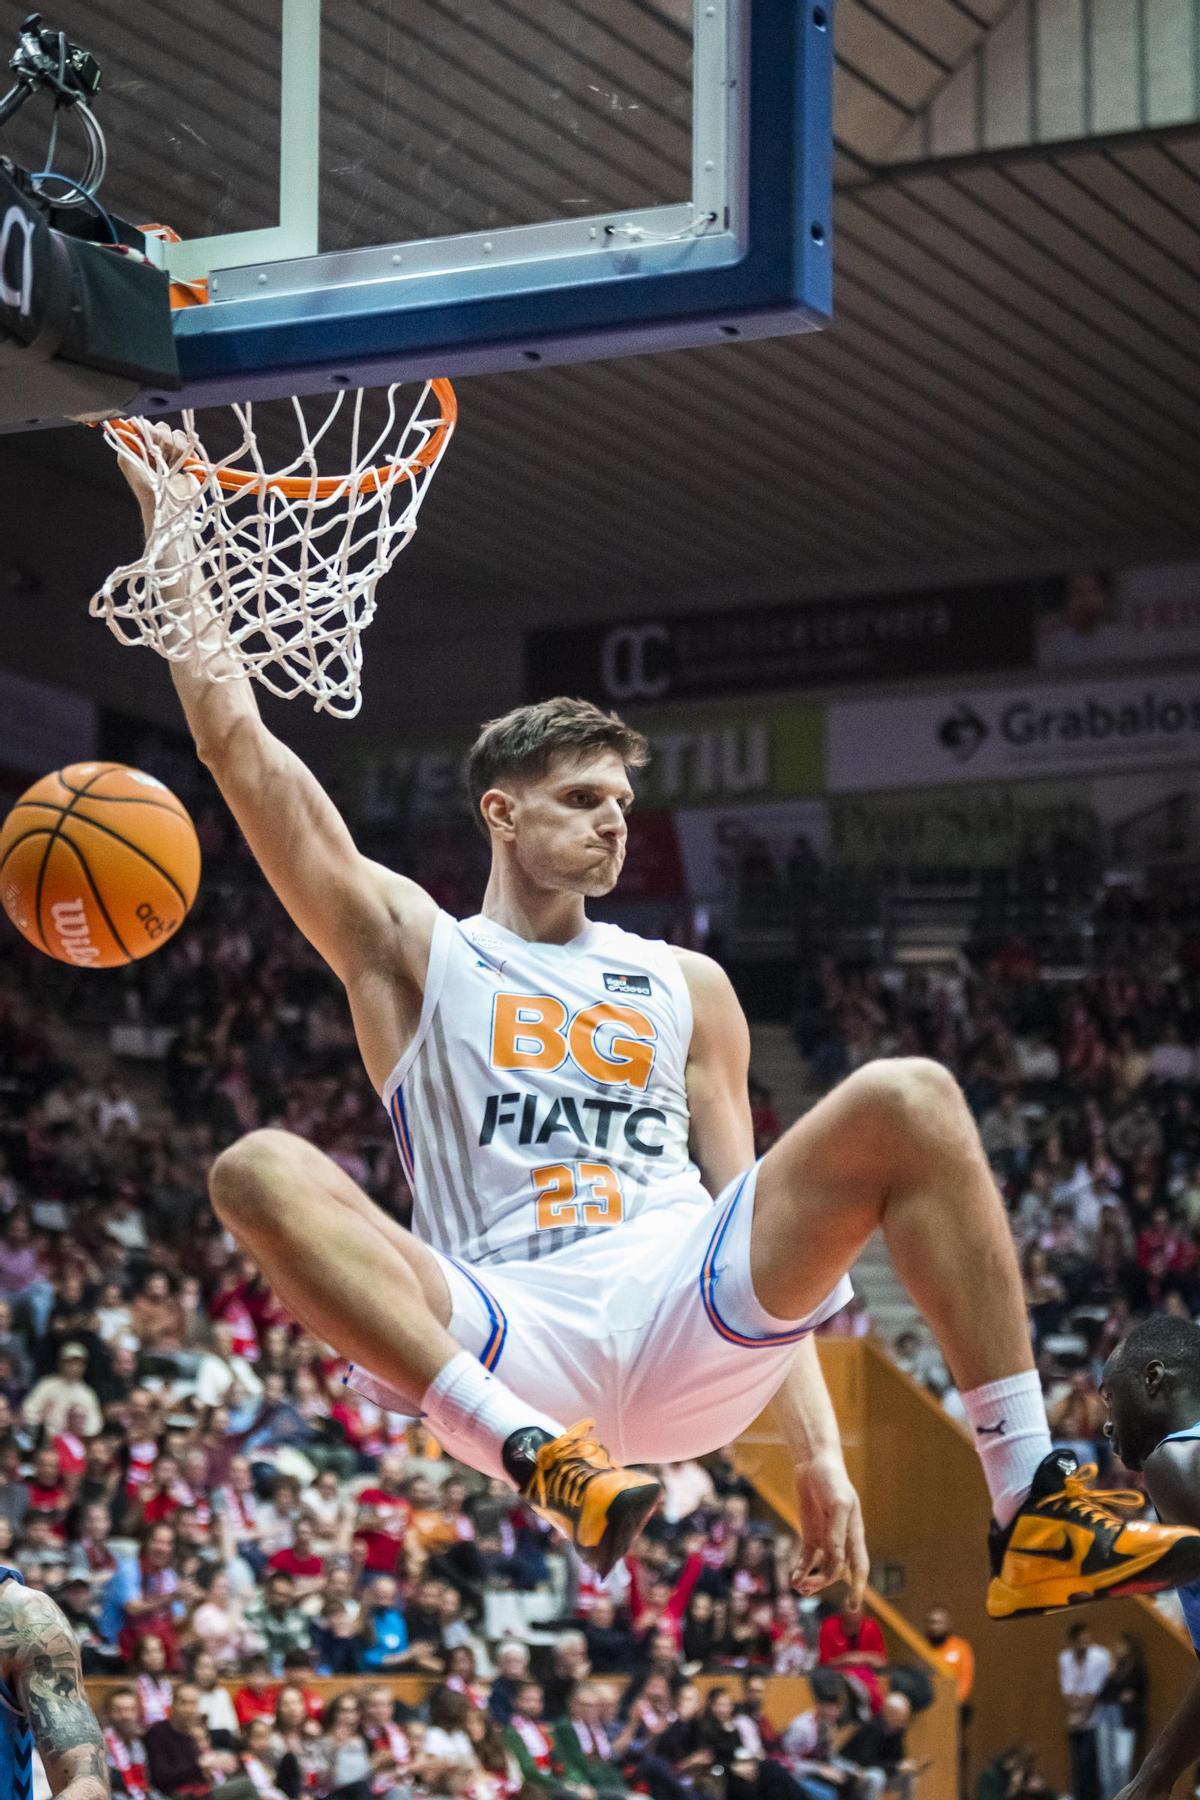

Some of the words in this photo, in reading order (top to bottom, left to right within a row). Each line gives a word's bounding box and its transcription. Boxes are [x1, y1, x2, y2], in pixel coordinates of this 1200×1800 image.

[490, 991, 657, 1092] BG
[478, 1092, 666, 1157] FIATC
[531, 1161, 624, 1231] 23
